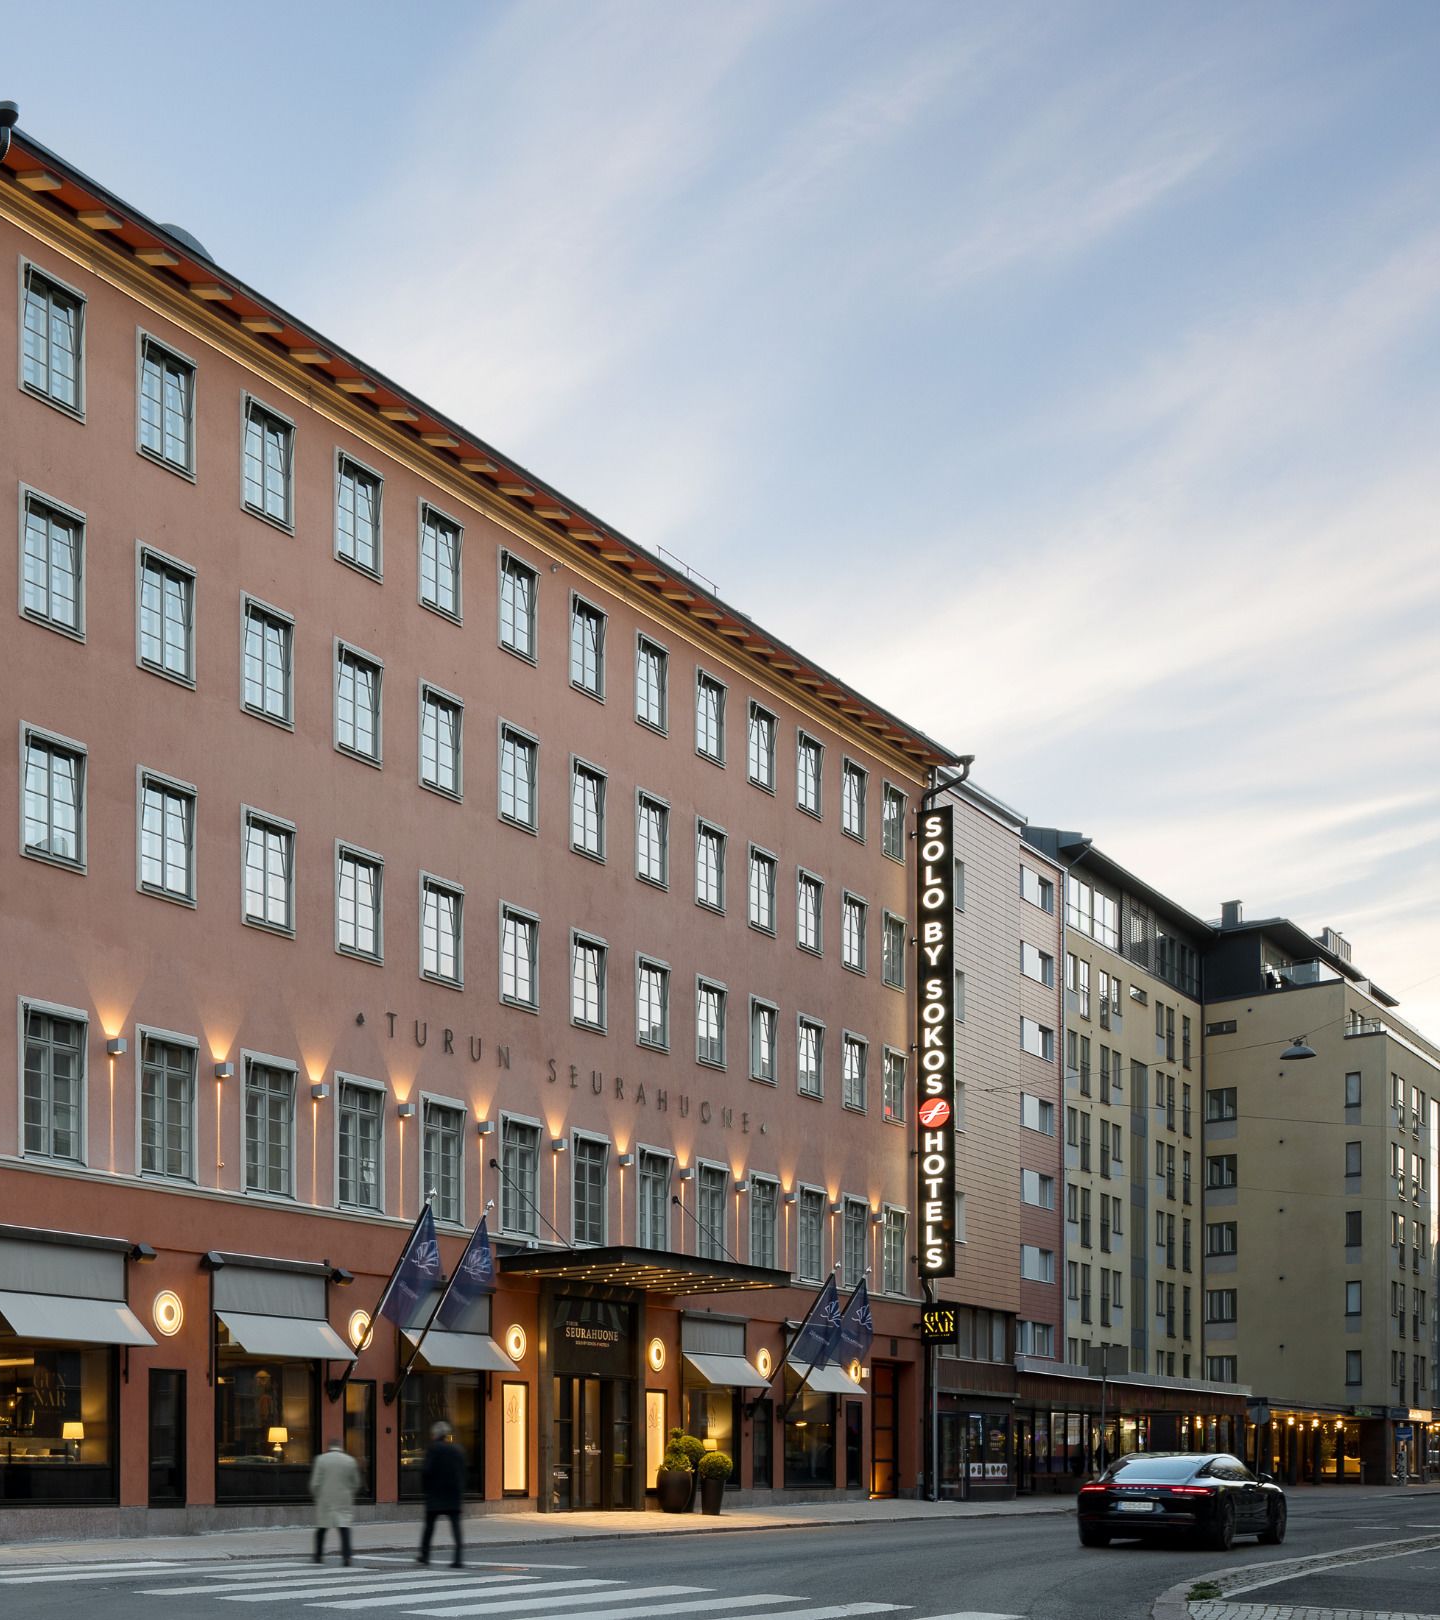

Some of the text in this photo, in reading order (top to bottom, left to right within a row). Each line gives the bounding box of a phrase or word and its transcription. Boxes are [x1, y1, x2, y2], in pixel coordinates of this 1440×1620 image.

[386, 1011, 750, 1134] TURUN SEURAHUONE
[922, 816, 946, 1269] SOLO BY SOKOS HOTELS
[565, 1327, 619, 1342] SEURAHUONE
